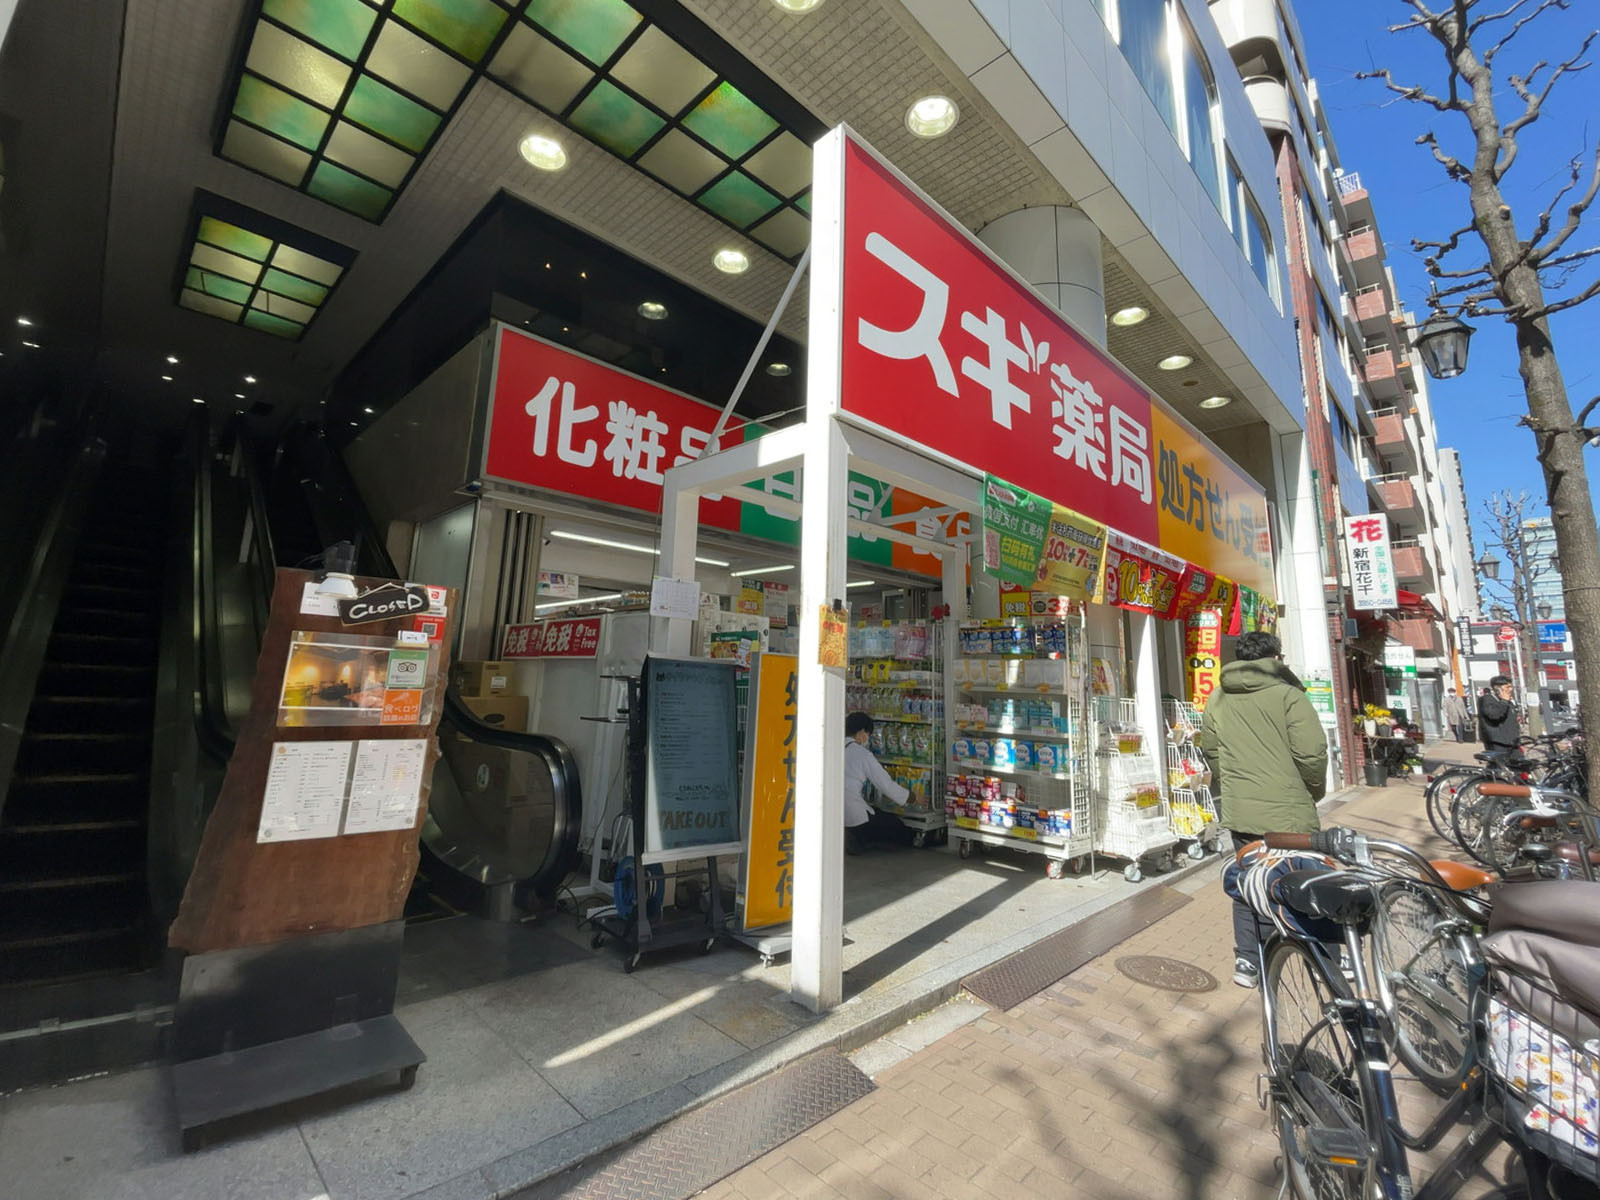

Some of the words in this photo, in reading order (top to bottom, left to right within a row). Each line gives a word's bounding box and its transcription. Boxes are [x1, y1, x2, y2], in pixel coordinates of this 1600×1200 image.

[858, 231, 1152, 505] スギ薬局
[1350, 519, 1383, 543] 花
[1353, 546, 1374, 596] 新宿花千
[349, 593, 423, 620] CLOSED
[508, 625, 529, 652] 免税
[543, 620, 573, 652] 免税
[581, 637, 598, 649] Free
[583, 625, 597, 637] Tax
[1187, 629, 1217, 648] 本日
[1192, 696, 1209, 705] OF
[694, 810, 729, 830] OUT
